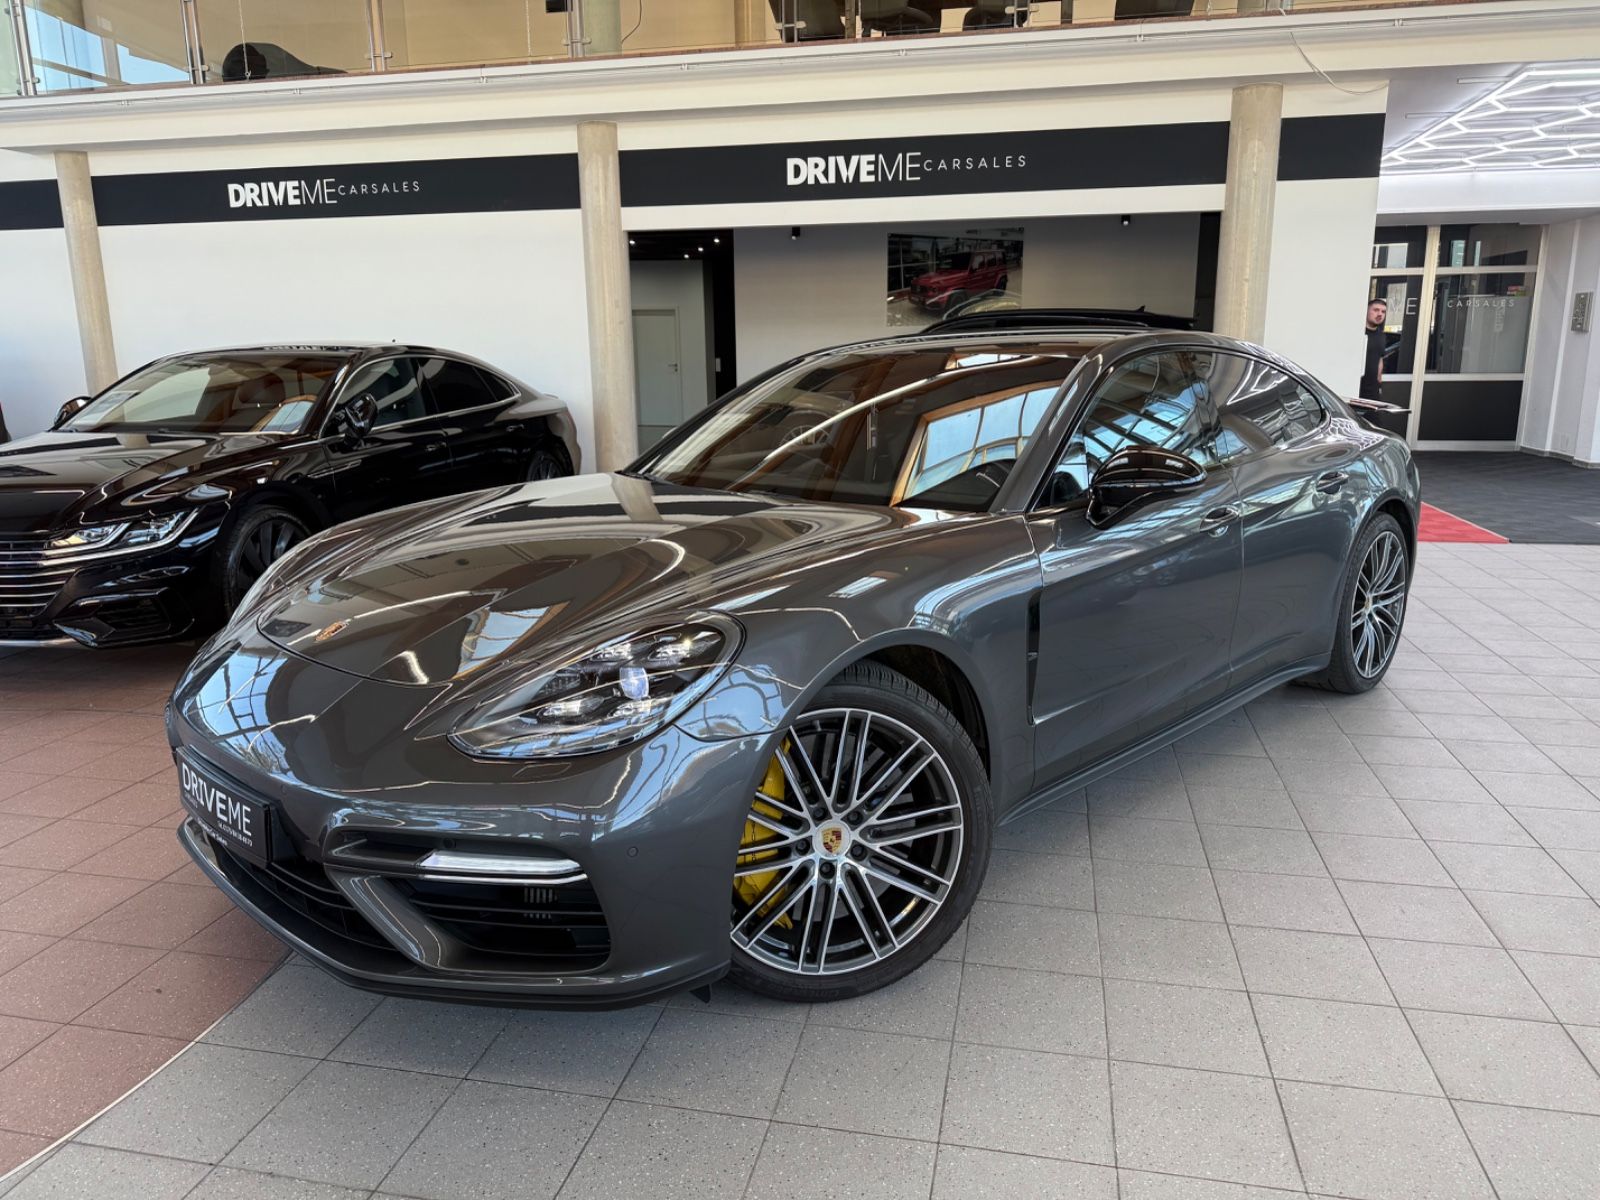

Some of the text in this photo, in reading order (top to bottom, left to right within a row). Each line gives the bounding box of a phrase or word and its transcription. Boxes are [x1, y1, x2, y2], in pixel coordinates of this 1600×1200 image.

[923, 155, 1027, 172] CARSALES
[338, 180, 420, 196] CARSALES
[1447, 298, 1515, 309] CARSALES
[182, 762, 252, 837] DRIVEME
